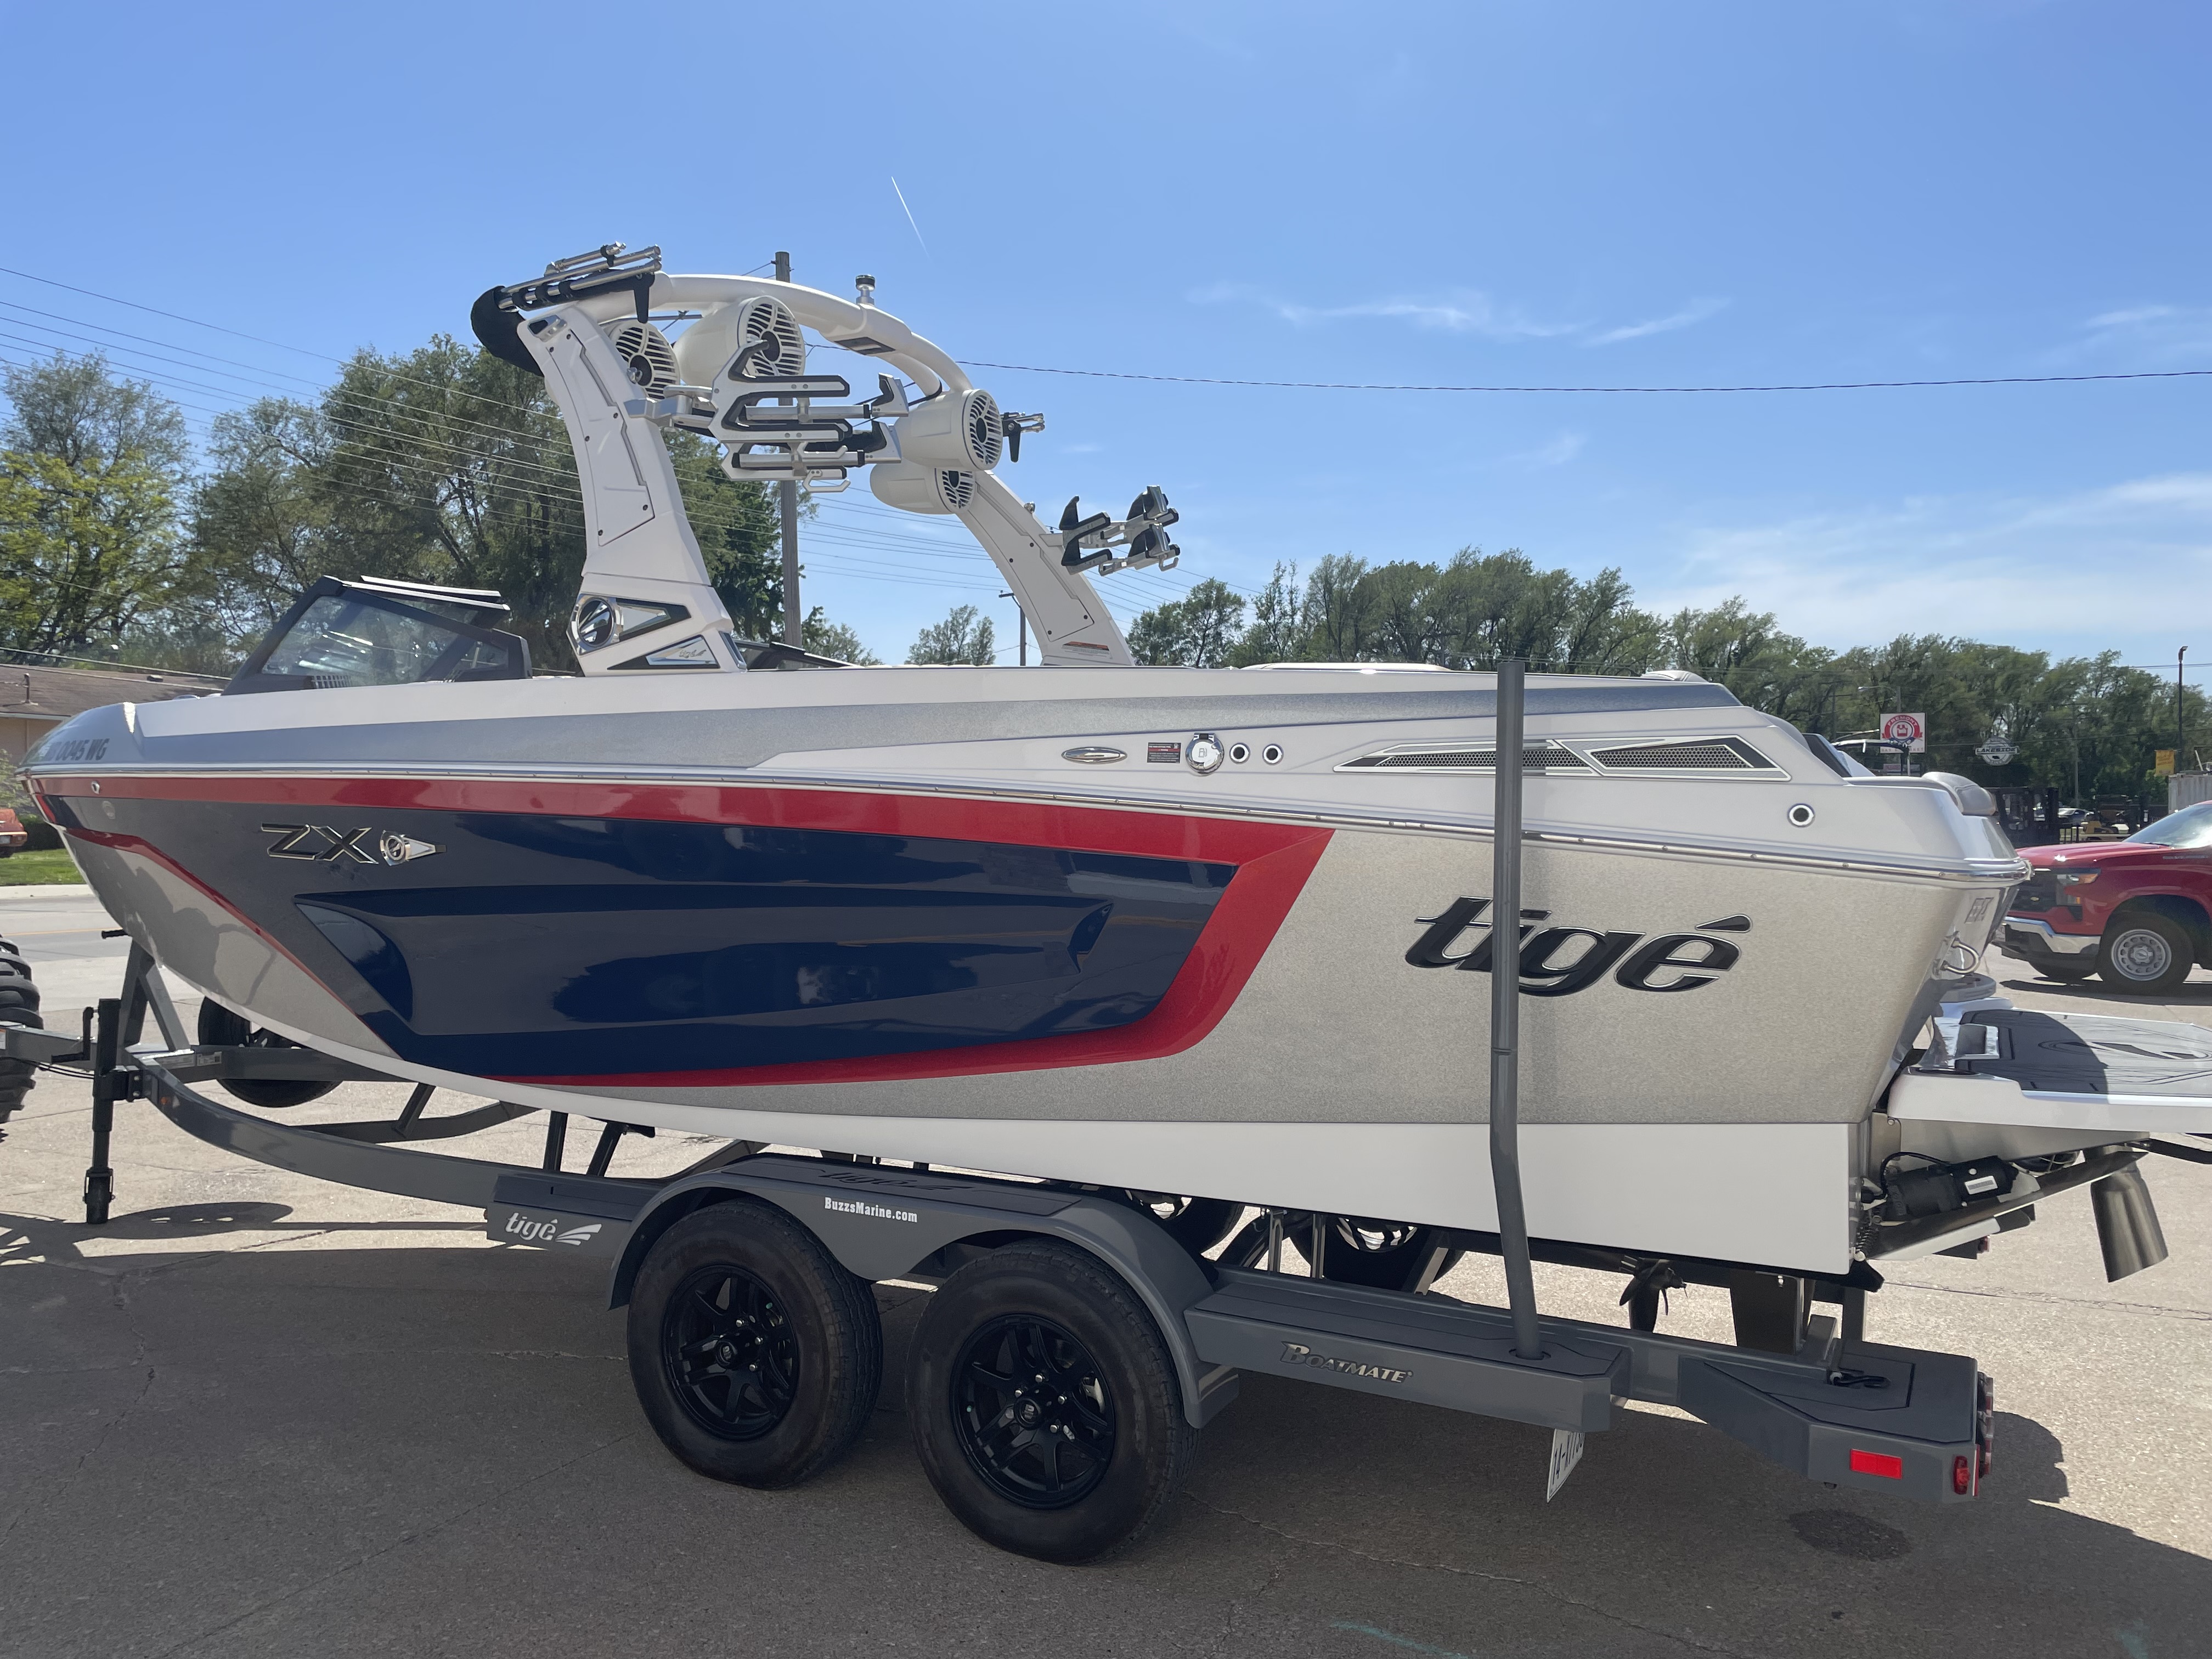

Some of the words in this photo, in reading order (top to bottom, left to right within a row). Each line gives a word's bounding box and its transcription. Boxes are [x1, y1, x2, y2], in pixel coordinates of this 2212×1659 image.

[261, 822, 379, 865] ZX
[825, 1197, 918, 1223] BuzzsMarine.com
[505, 1212, 558, 1241] tigé
